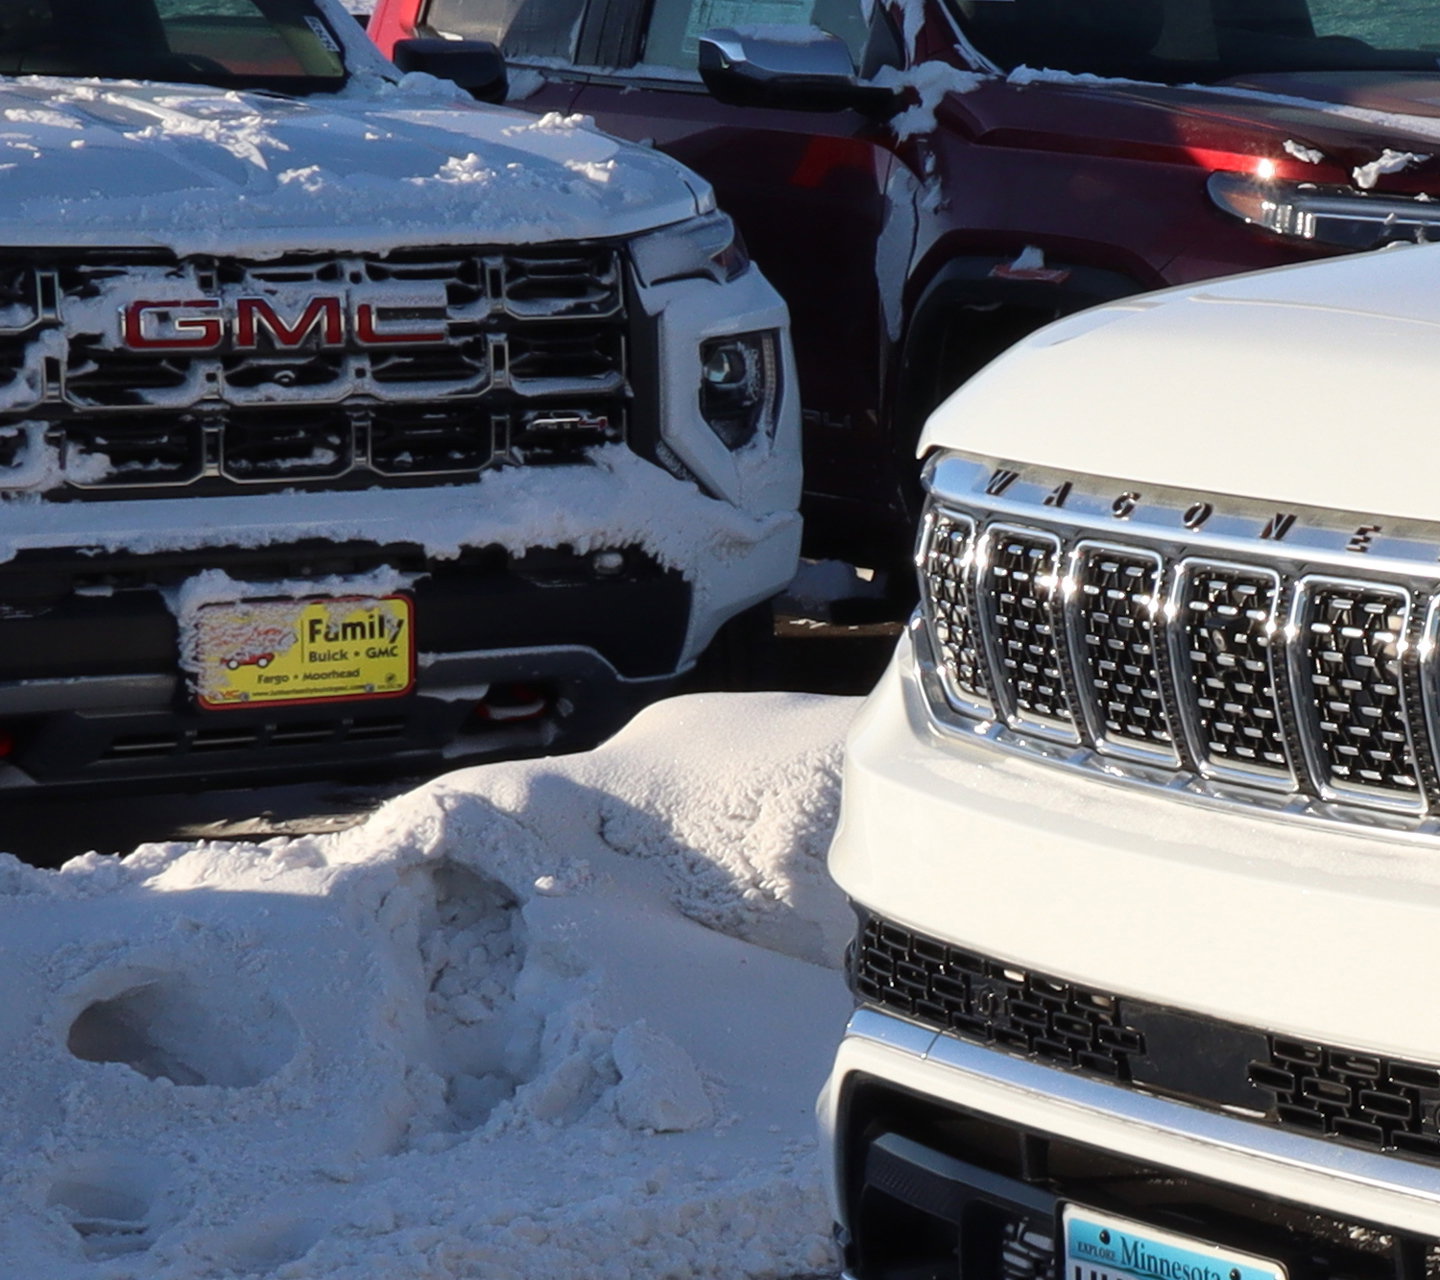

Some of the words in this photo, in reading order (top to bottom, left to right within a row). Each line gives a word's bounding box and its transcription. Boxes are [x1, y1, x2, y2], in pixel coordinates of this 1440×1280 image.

[122, 294, 447, 353] GMC
[308, 613, 405, 644] Family
[308, 650, 348, 663] Buick
[365, 646, 399, 659] GMC
[257, 673, 289, 685] Fargo
[302, 668, 361, 682] Moorhead
[1077, 1241, 1117, 1262] EXPLORE
